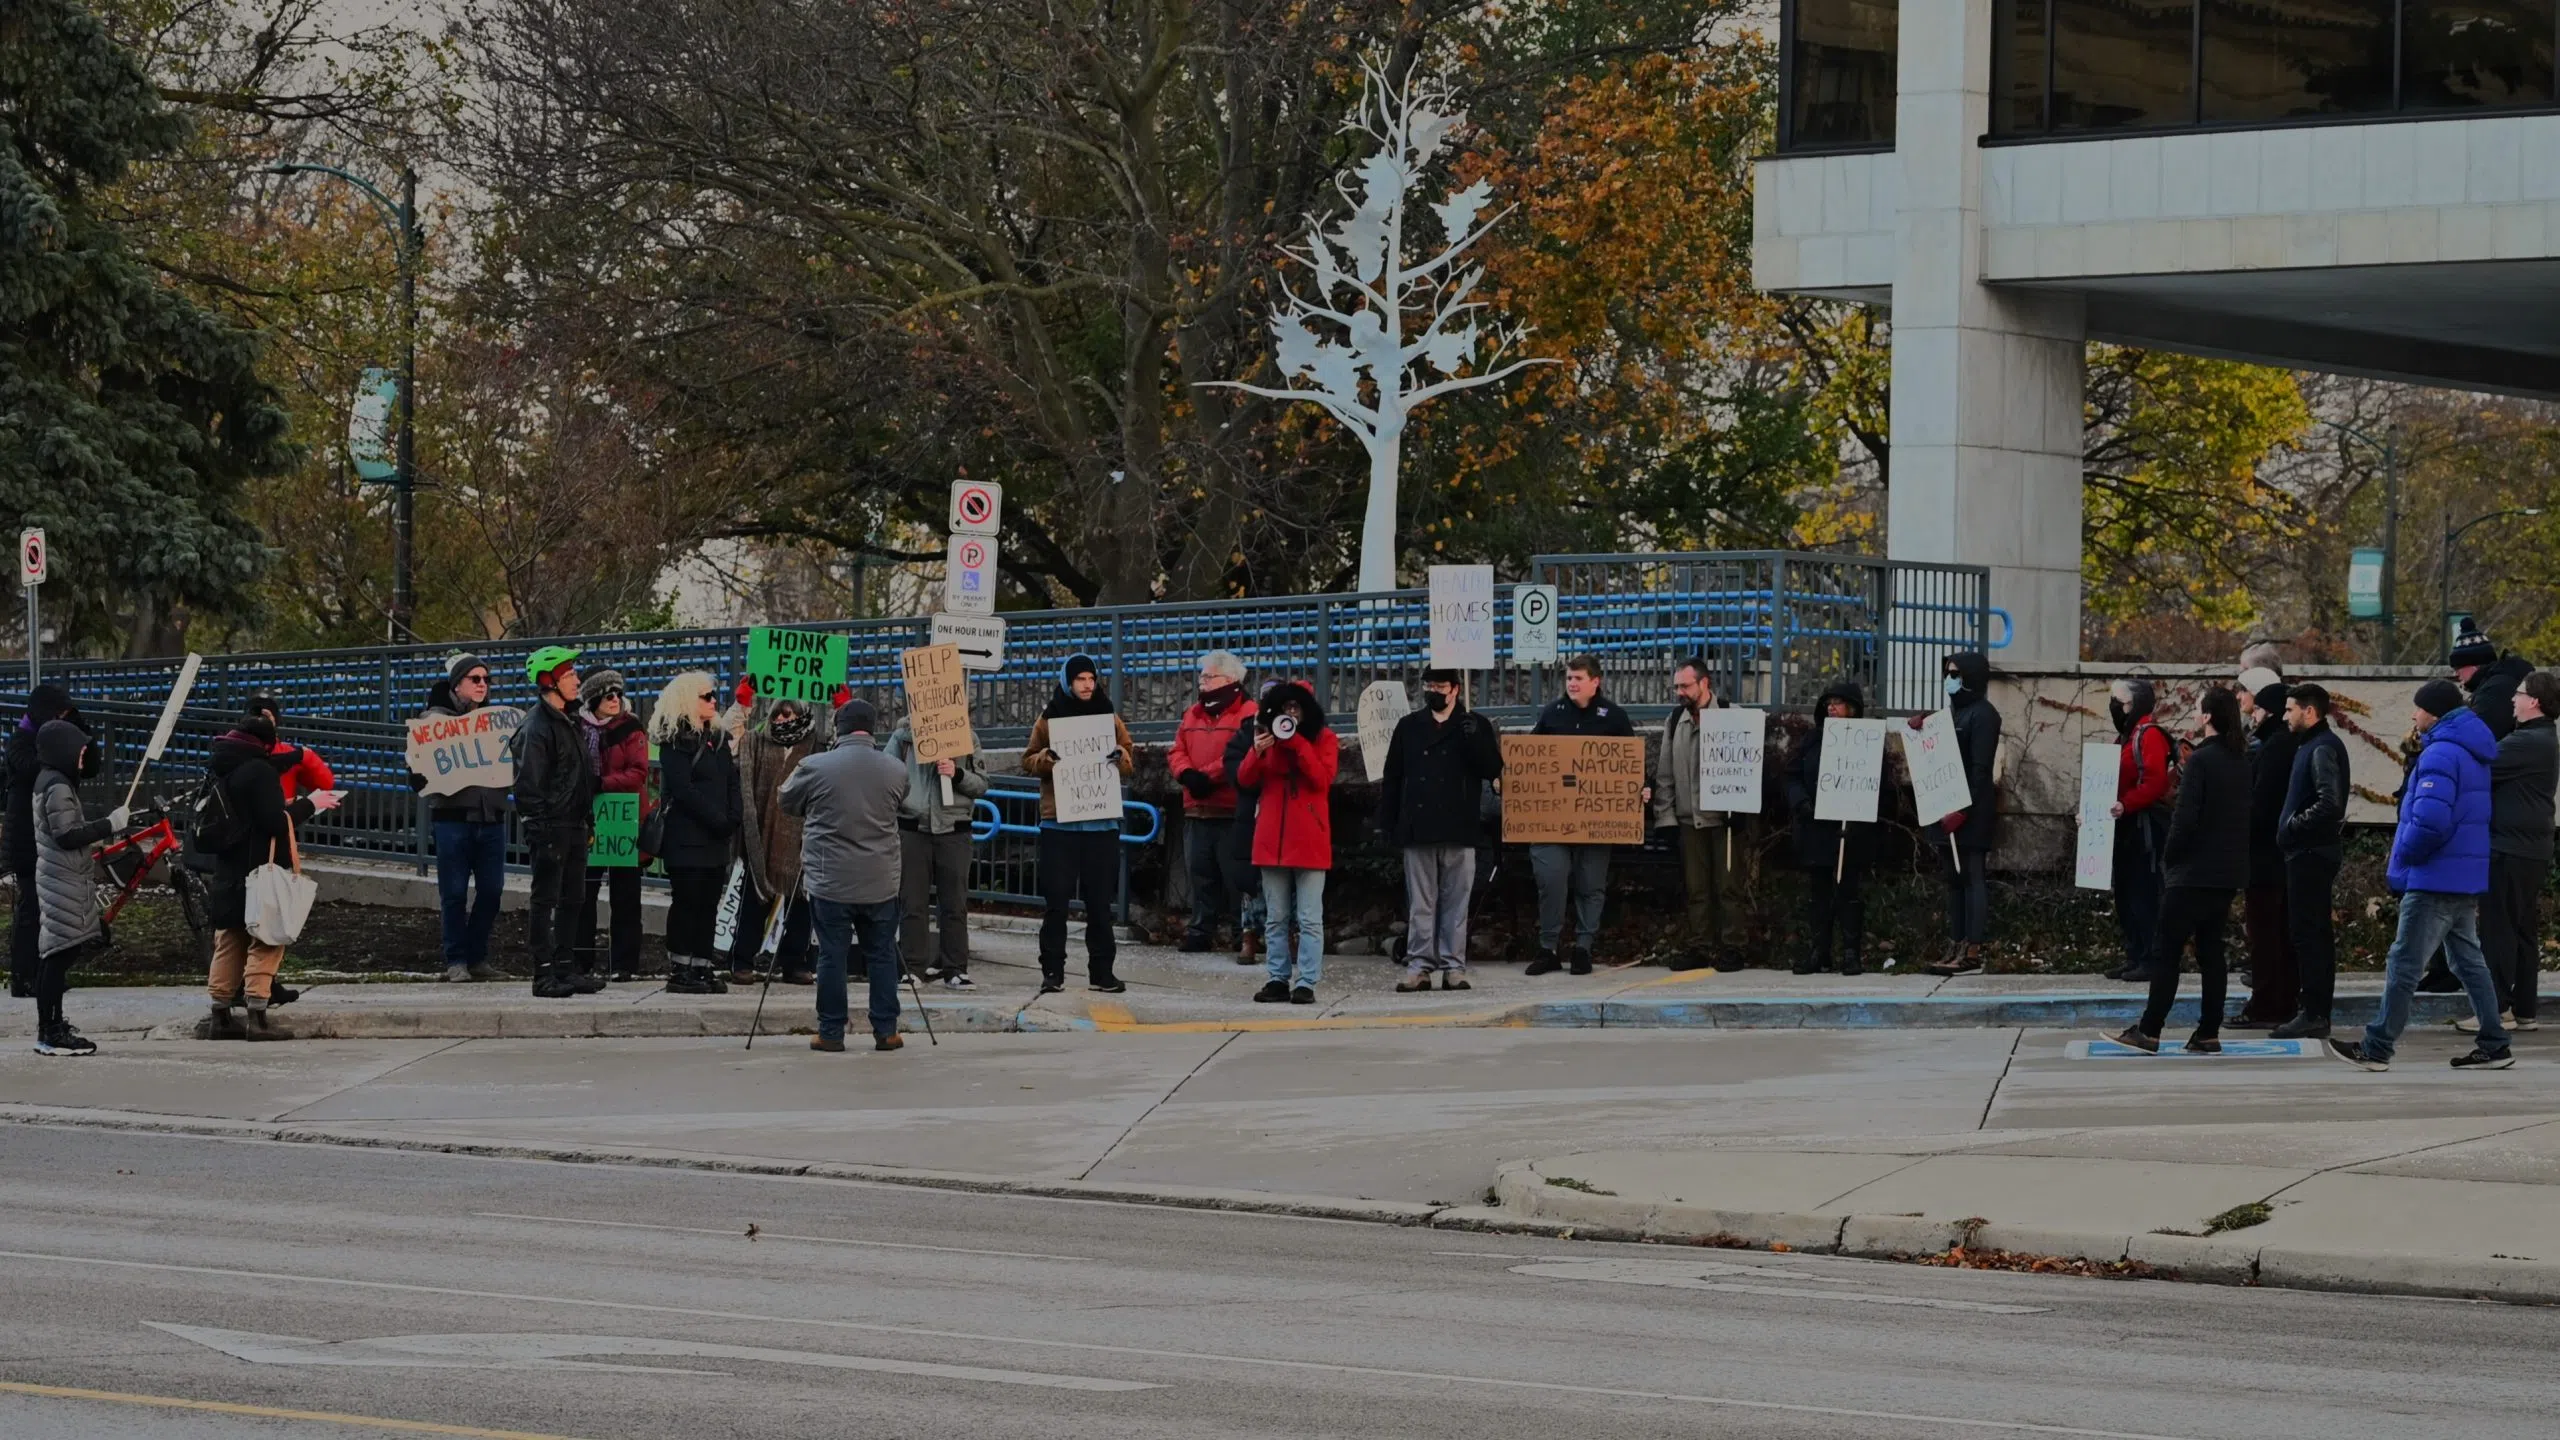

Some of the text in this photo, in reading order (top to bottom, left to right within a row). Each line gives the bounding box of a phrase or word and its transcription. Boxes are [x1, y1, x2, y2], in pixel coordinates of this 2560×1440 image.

[1433, 601, 1490, 624] HOMES
[938, 625, 1000, 639] ONE HOUR LIMIT
[769, 629, 829, 655] HONK
[778, 654, 823, 678] FOR
[904, 648, 952, 679] HELP
[748, 672, 842, 702] ACTION
[917, 679, 939, 688] OUR
[1360, 689, 1393, 708] STOP
[412, 725, 433, 745] WE
[474, 709, 522, 733] AFFORD
[922, 713, 940, 725] NOT
[1053, 735, 1113, 757] TENANT
[1703, 731, 1751, 744] INSPECT
[434, 738, 493, 775] BILL
[1581, 740, 1636, 759] MORE
[1702, 746, 1762, 763] LANDLORDS
[1503, 761, 1560, 776] HOMES
[1572, 758, 1642, 774] NATURE
[1701, 767, 1753, 777] FREQUENTLY
[1837, 756, 1866, 771] the
[1060, 760, 1112, 786] RIGHTS
[1071, 784, 1108, 801] NOW
[1511, 780, 1557, 794] BUILT
[1578, 780, 1639, 795] KILLED
[596, 800, 635, 822] ATE
[1575, 797, 1643, 814] FASTER!
[1528, 822, 1558, 832] STILL
[1580, 820, 1641, 830] AFFORDABLE
[594, 834, 637, 857] ENCY
